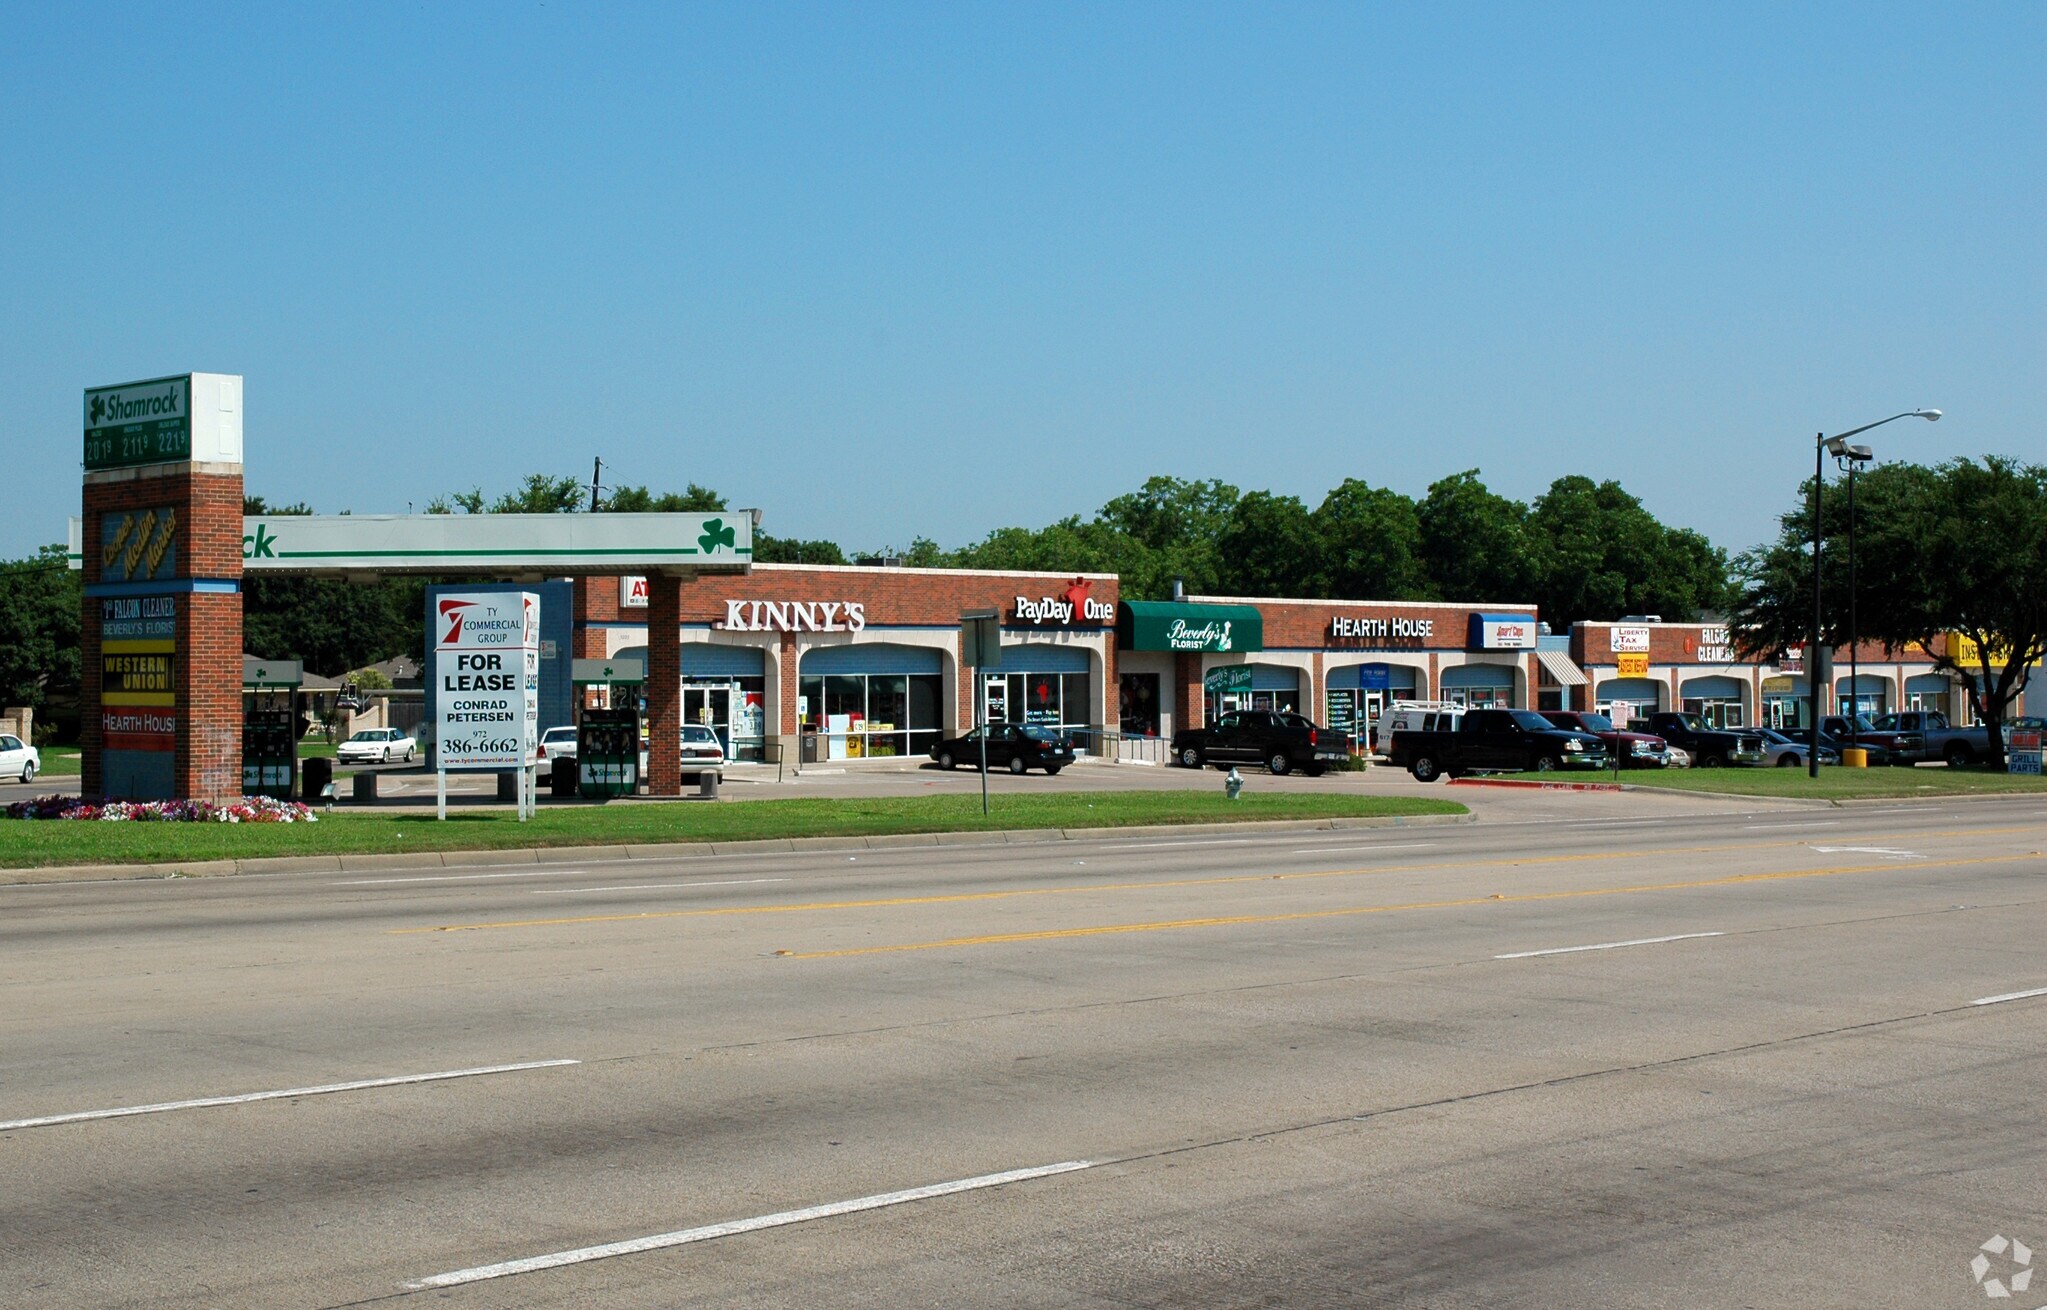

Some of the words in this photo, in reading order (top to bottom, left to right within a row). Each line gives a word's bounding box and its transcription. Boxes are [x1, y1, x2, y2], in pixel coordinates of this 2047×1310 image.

[107, 386, 178, 422] Shamrock
[146, 506, 176, 579] Market
[114, 598, 140, 619] FALCON
[487, 607, 498, 616] TY
[725, 599, 865, 632] KINNY'S
[1016, 596, 1073, 624] PayDay
[1084, 598, 1113, 619] One
[103, 622, 143, 635] BEVERLY'S
[463, 620, 521, 630] COMMERCIAL
[1167, 619, 1220, 645] Beverly's
[1333, 617, 1387, 636] HEARTH
[1392, 618, 1433, 636] HOUSE
[477, 634, 508, 643] GROUP
[1171, 639, 1203, 649] FLORIST
[105, 657, 165, 672] WESTERN
[458, 654, 502, 671] FOR
[123, 674, 165, 689] UNION
[444, 674, 515, 691] LEASE
[453, 700, 508, 710] CONRAD
[102, 713, 142, 731] HEARTH
[447, 712, 514, 722] PETERSEN
[442, 738, 518, 753] 386-6662
[2012, 754, 2038, 764] GRILL
[2011, 764, 2039, 773] PARTS
